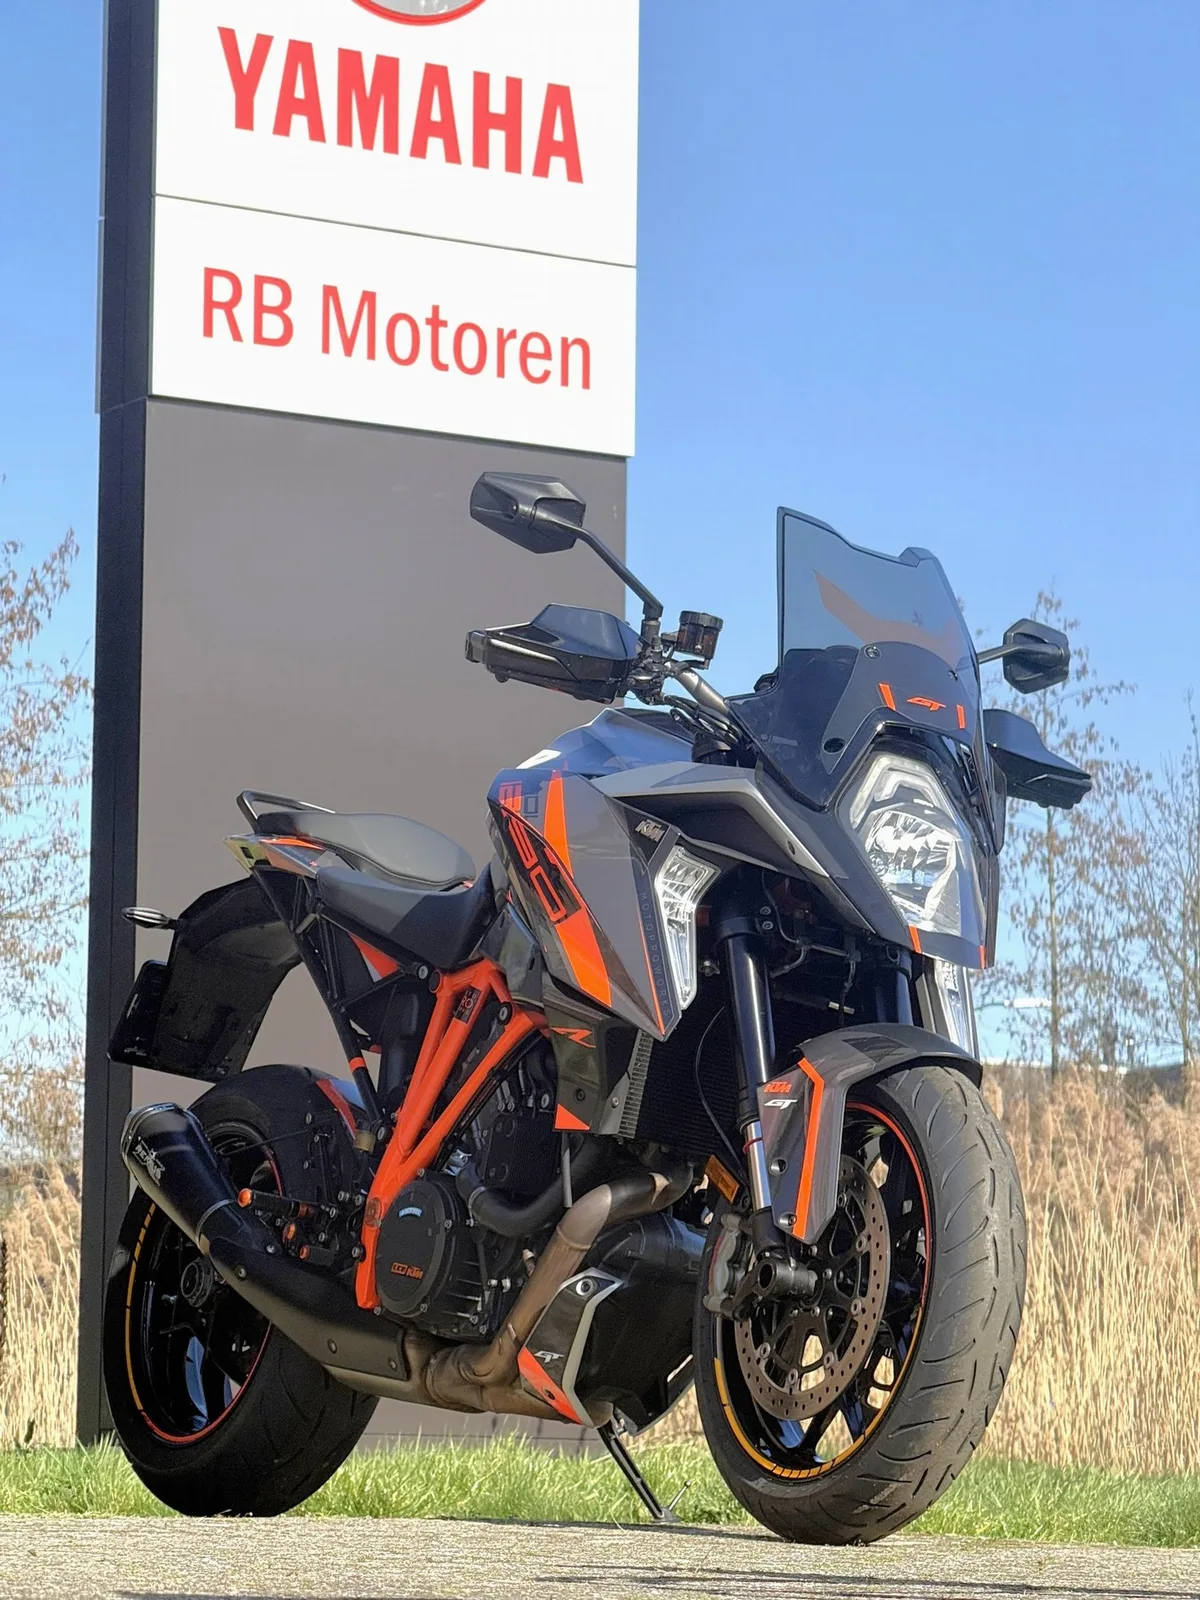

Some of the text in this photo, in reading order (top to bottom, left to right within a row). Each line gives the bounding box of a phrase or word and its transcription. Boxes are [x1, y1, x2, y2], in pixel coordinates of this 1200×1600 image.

[217, 26, 584, 184] YAMAHA
[202, 266, 591, 390] RB Motoren
[634, 818, 665, 843] KTM
[763, 1081, 792, 1094] KTM
[764, 1098, 798, 1110] GT
